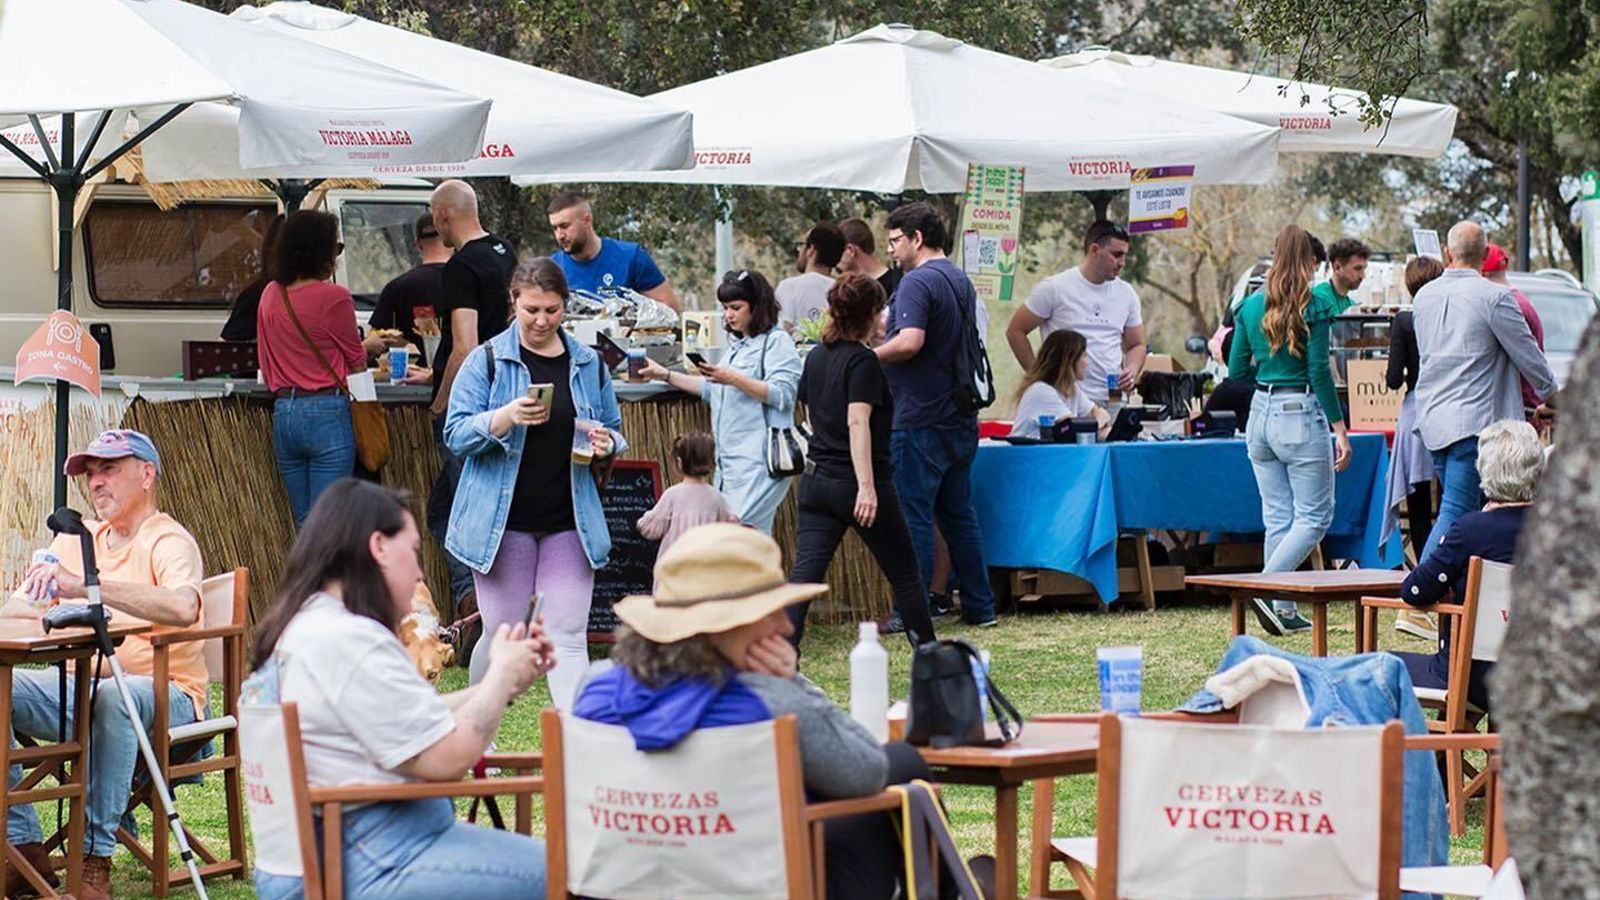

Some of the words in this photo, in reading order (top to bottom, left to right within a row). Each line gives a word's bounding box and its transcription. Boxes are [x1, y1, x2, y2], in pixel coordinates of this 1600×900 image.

[1280, 117, 1331, 129] VICTORIA
[319, 129, 366, 146] VICTORIA
[367, 127, 413, 145] MÁLAGA
[695, 152, 752, 164] ICTORIA
[1069, 160, 1132, 175] VICTORIA
[373, 165, 414, 174] CERVEZA
[415, 164, 445, 173] DESDE
[973, 208, 1012, 220] COMIDA
[27, 350, 55, 363] ZONA
[57, 351, 94, 375] GASTRO
[595, 786, 720, 809] CERVEZAS
[1178, 784, 1323, 807] CERVEZAS
[588, 804, 736, 835] VICTORIA
[1164, 806, 1336, 834] VICTORIA
